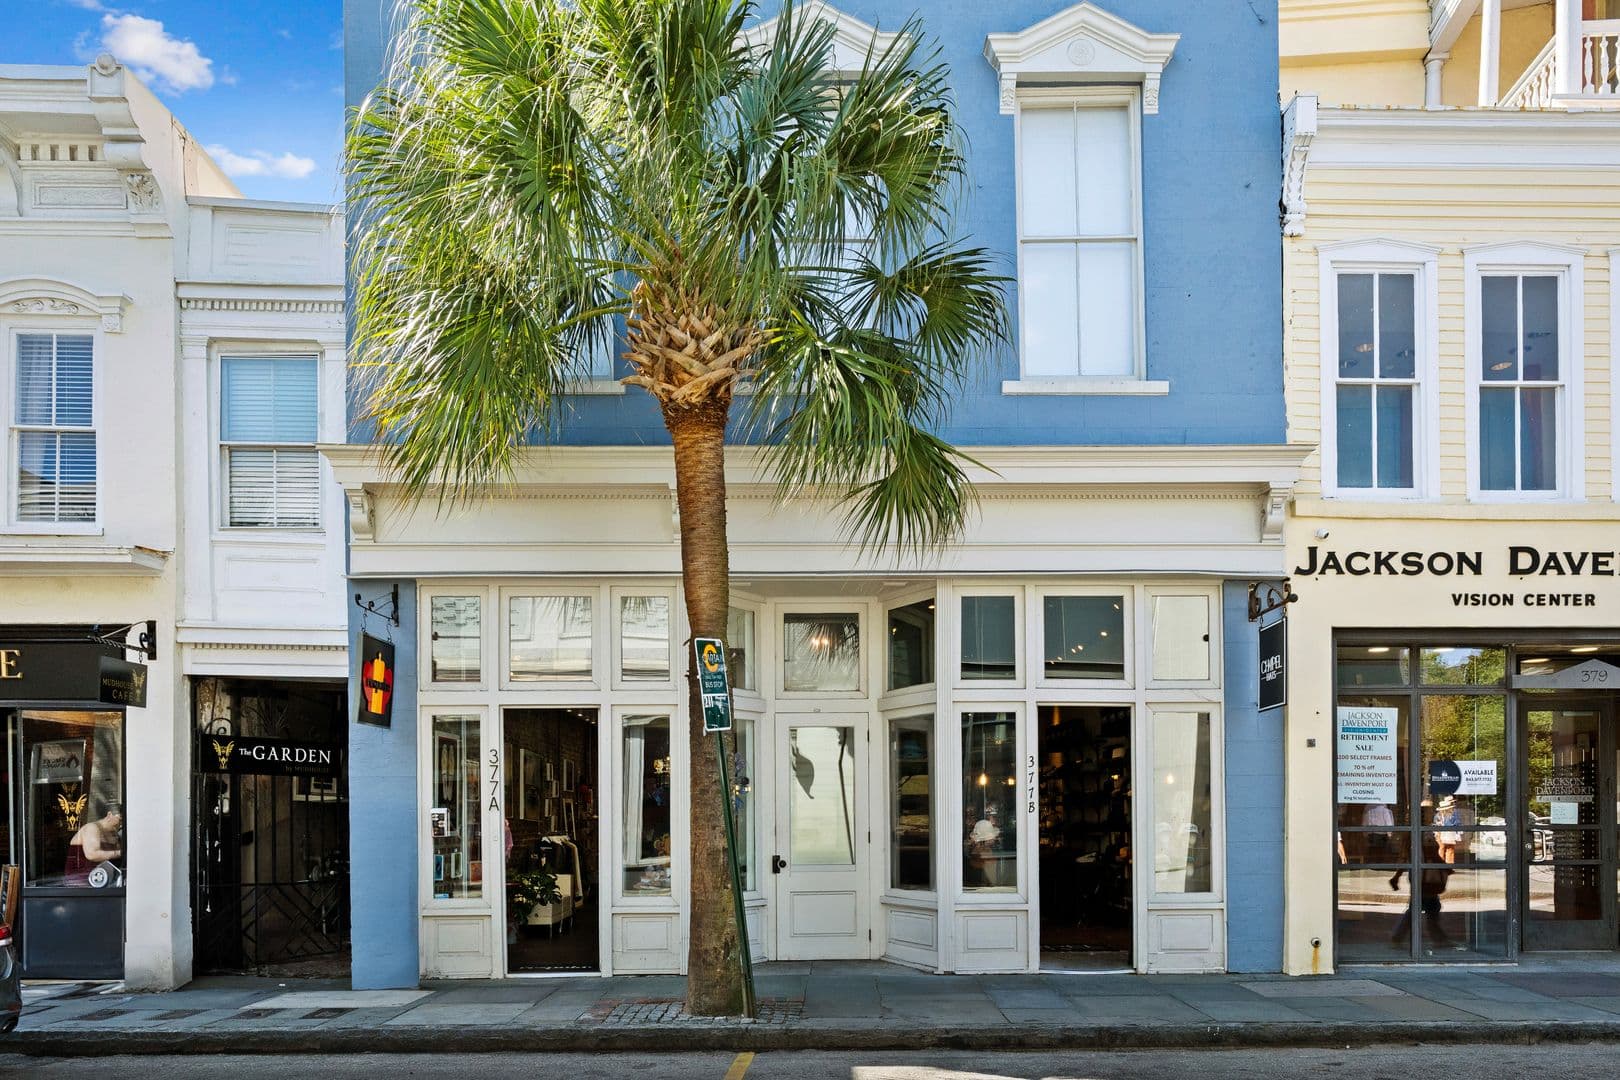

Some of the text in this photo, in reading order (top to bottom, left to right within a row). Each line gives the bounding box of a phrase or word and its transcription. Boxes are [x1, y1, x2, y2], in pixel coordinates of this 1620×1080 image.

[1294, 546, 1620, 576] JACKSON DAVE
[1451, 593, 1596, 607] VISION CENTER
[1581, 670, 1608, 682] 379
[1341, 719, 1388, 727] DAVENPORT
[1347, 711, 1383, 720] JACKSON
[252, 745, 331, 764] GARDEN
[488, 748, 500, 811] 377A
[1028, 755, 1036, 814] 377B
